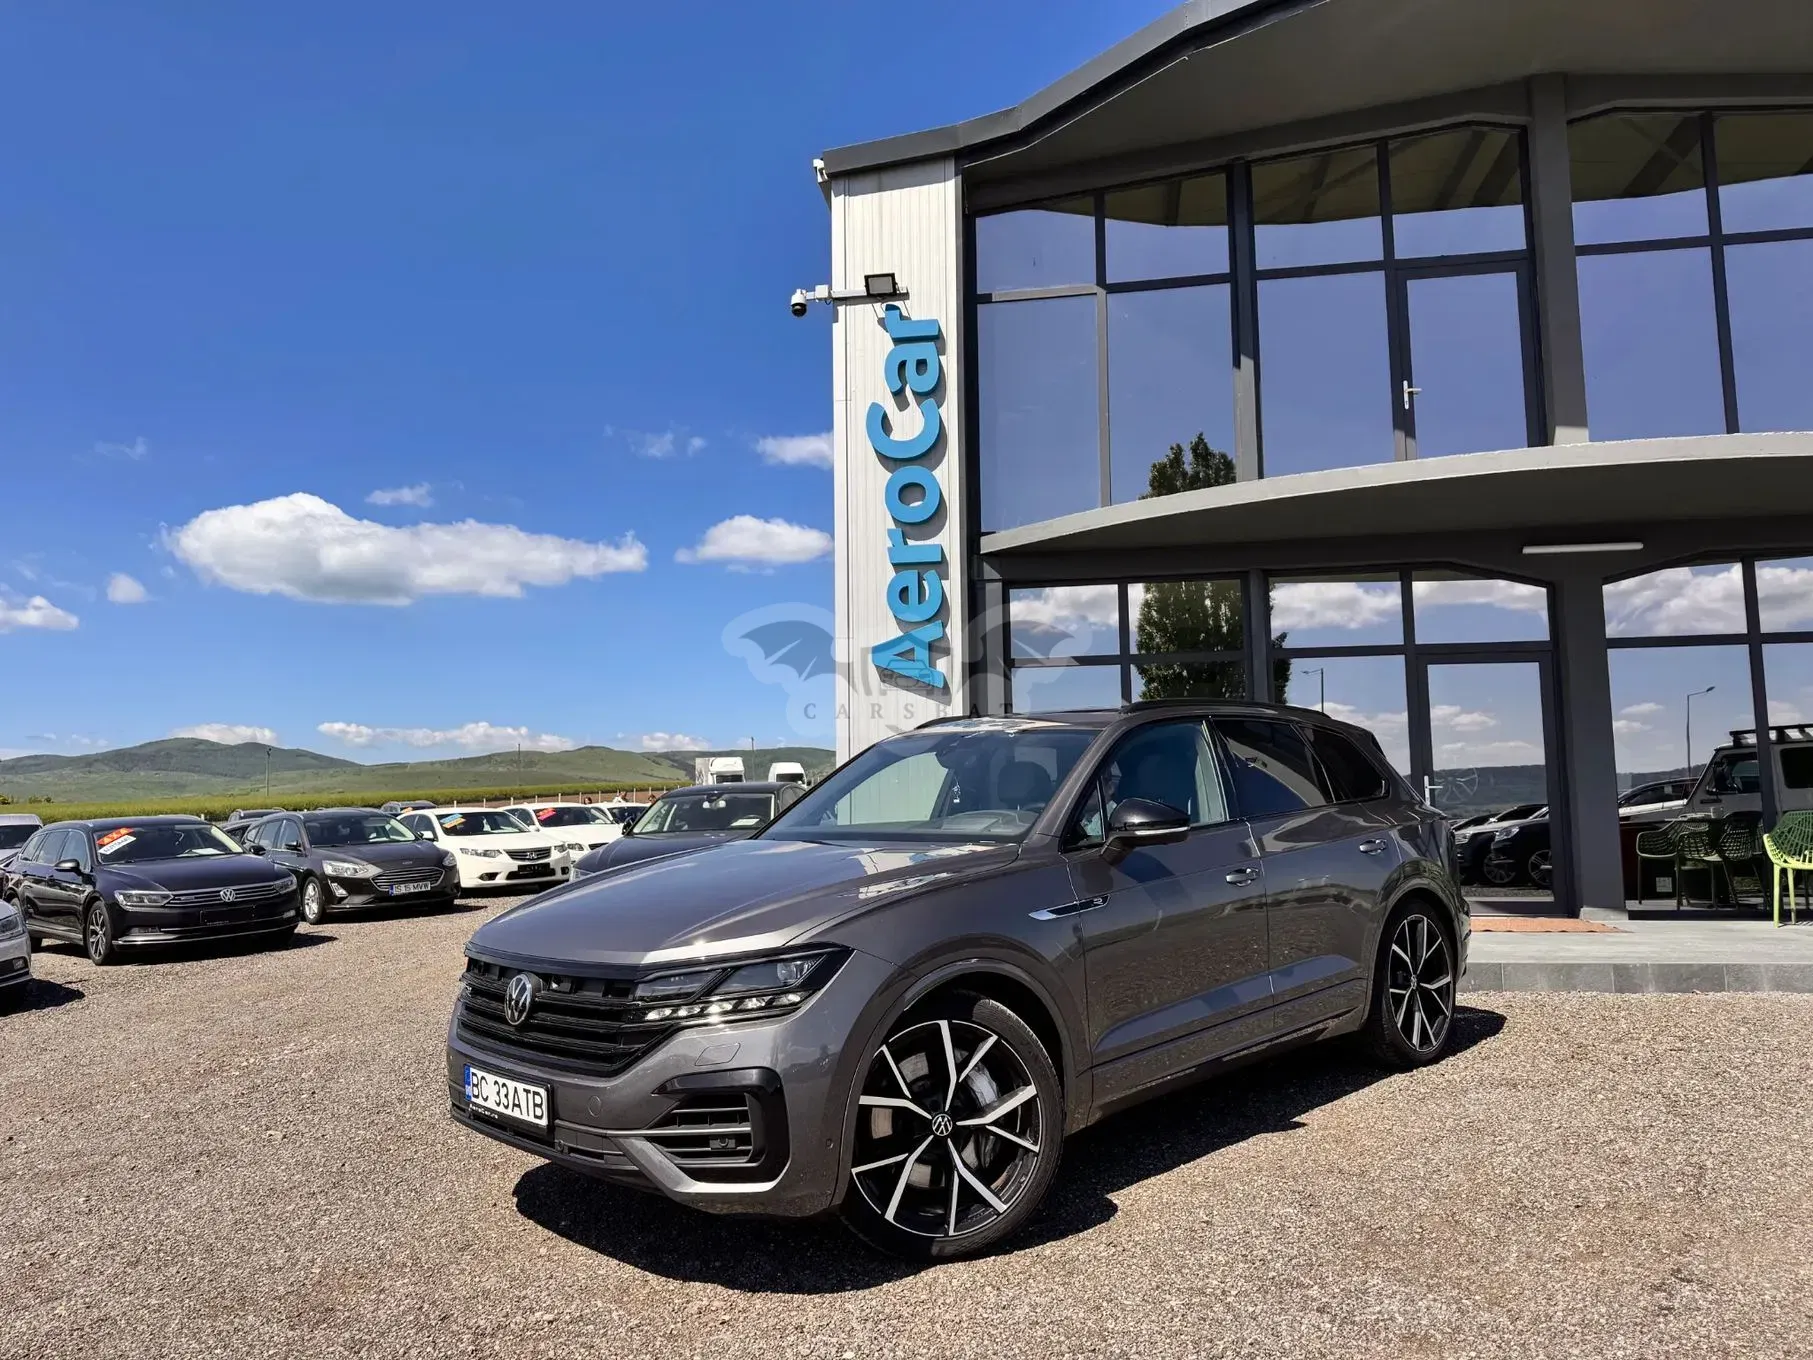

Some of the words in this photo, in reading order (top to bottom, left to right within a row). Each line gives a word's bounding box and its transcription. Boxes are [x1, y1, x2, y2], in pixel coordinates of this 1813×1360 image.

[866, 304, 944, 688] AeroCar
[471, 1071, 489, 1103] BC
[493, 1079, 544, 1120] 33ATB
